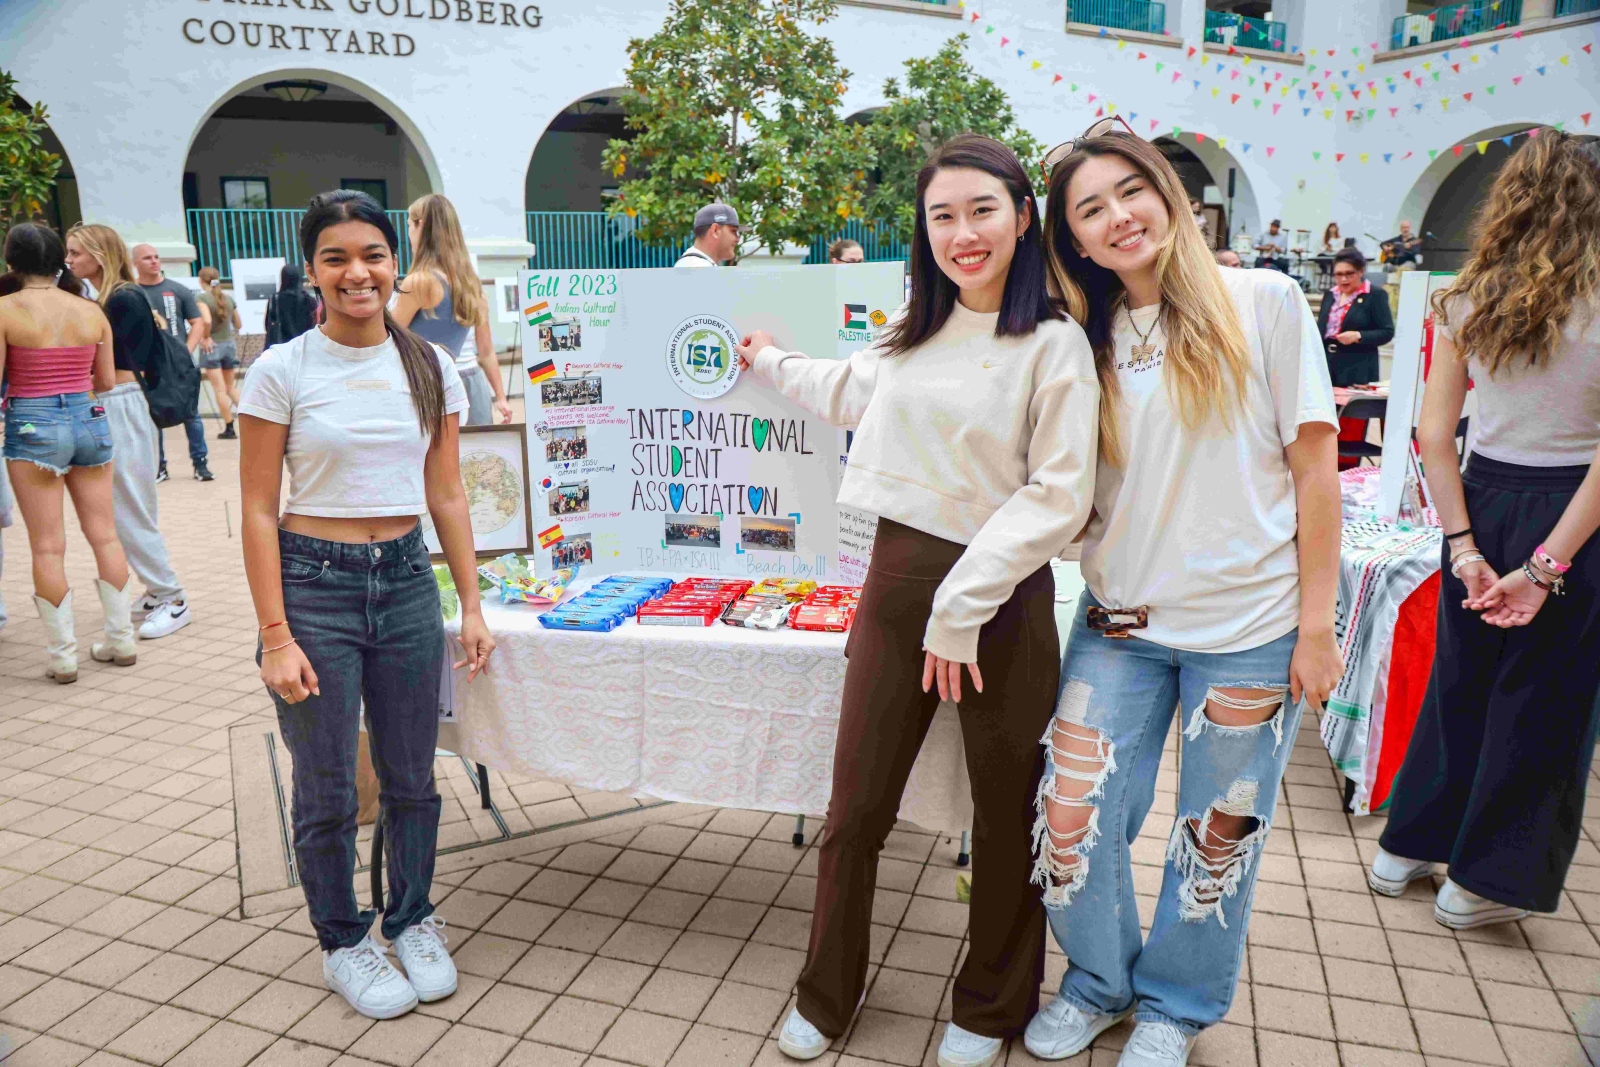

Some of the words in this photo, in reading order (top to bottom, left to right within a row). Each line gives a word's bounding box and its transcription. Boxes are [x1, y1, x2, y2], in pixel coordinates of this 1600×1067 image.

[347, 0, 543, 28] GOLDBERG
[182, 18, 416, 57] COURTYARD
[527, 274, 560, 299] Fall
[568, 274, 617, 296] 2023
[554, 302, 580, 313] Indian
[583, 301, 616, 313] Cultural
[589, 316, 611, 327] Hour
[838, 329, 872, 342] PALESTINE
[670, 322, 694, 377] INTERNATIONAL
[694, 318, 726, 331] STUDENT
[686, 343, 723, 369] ISA
[1134, 360, 1162, 374] PARIS
[581, 459, 599, 467] SDSU
[631, 443, 722, 478] STUDENT
[746, 554, 786, 574] Beach
